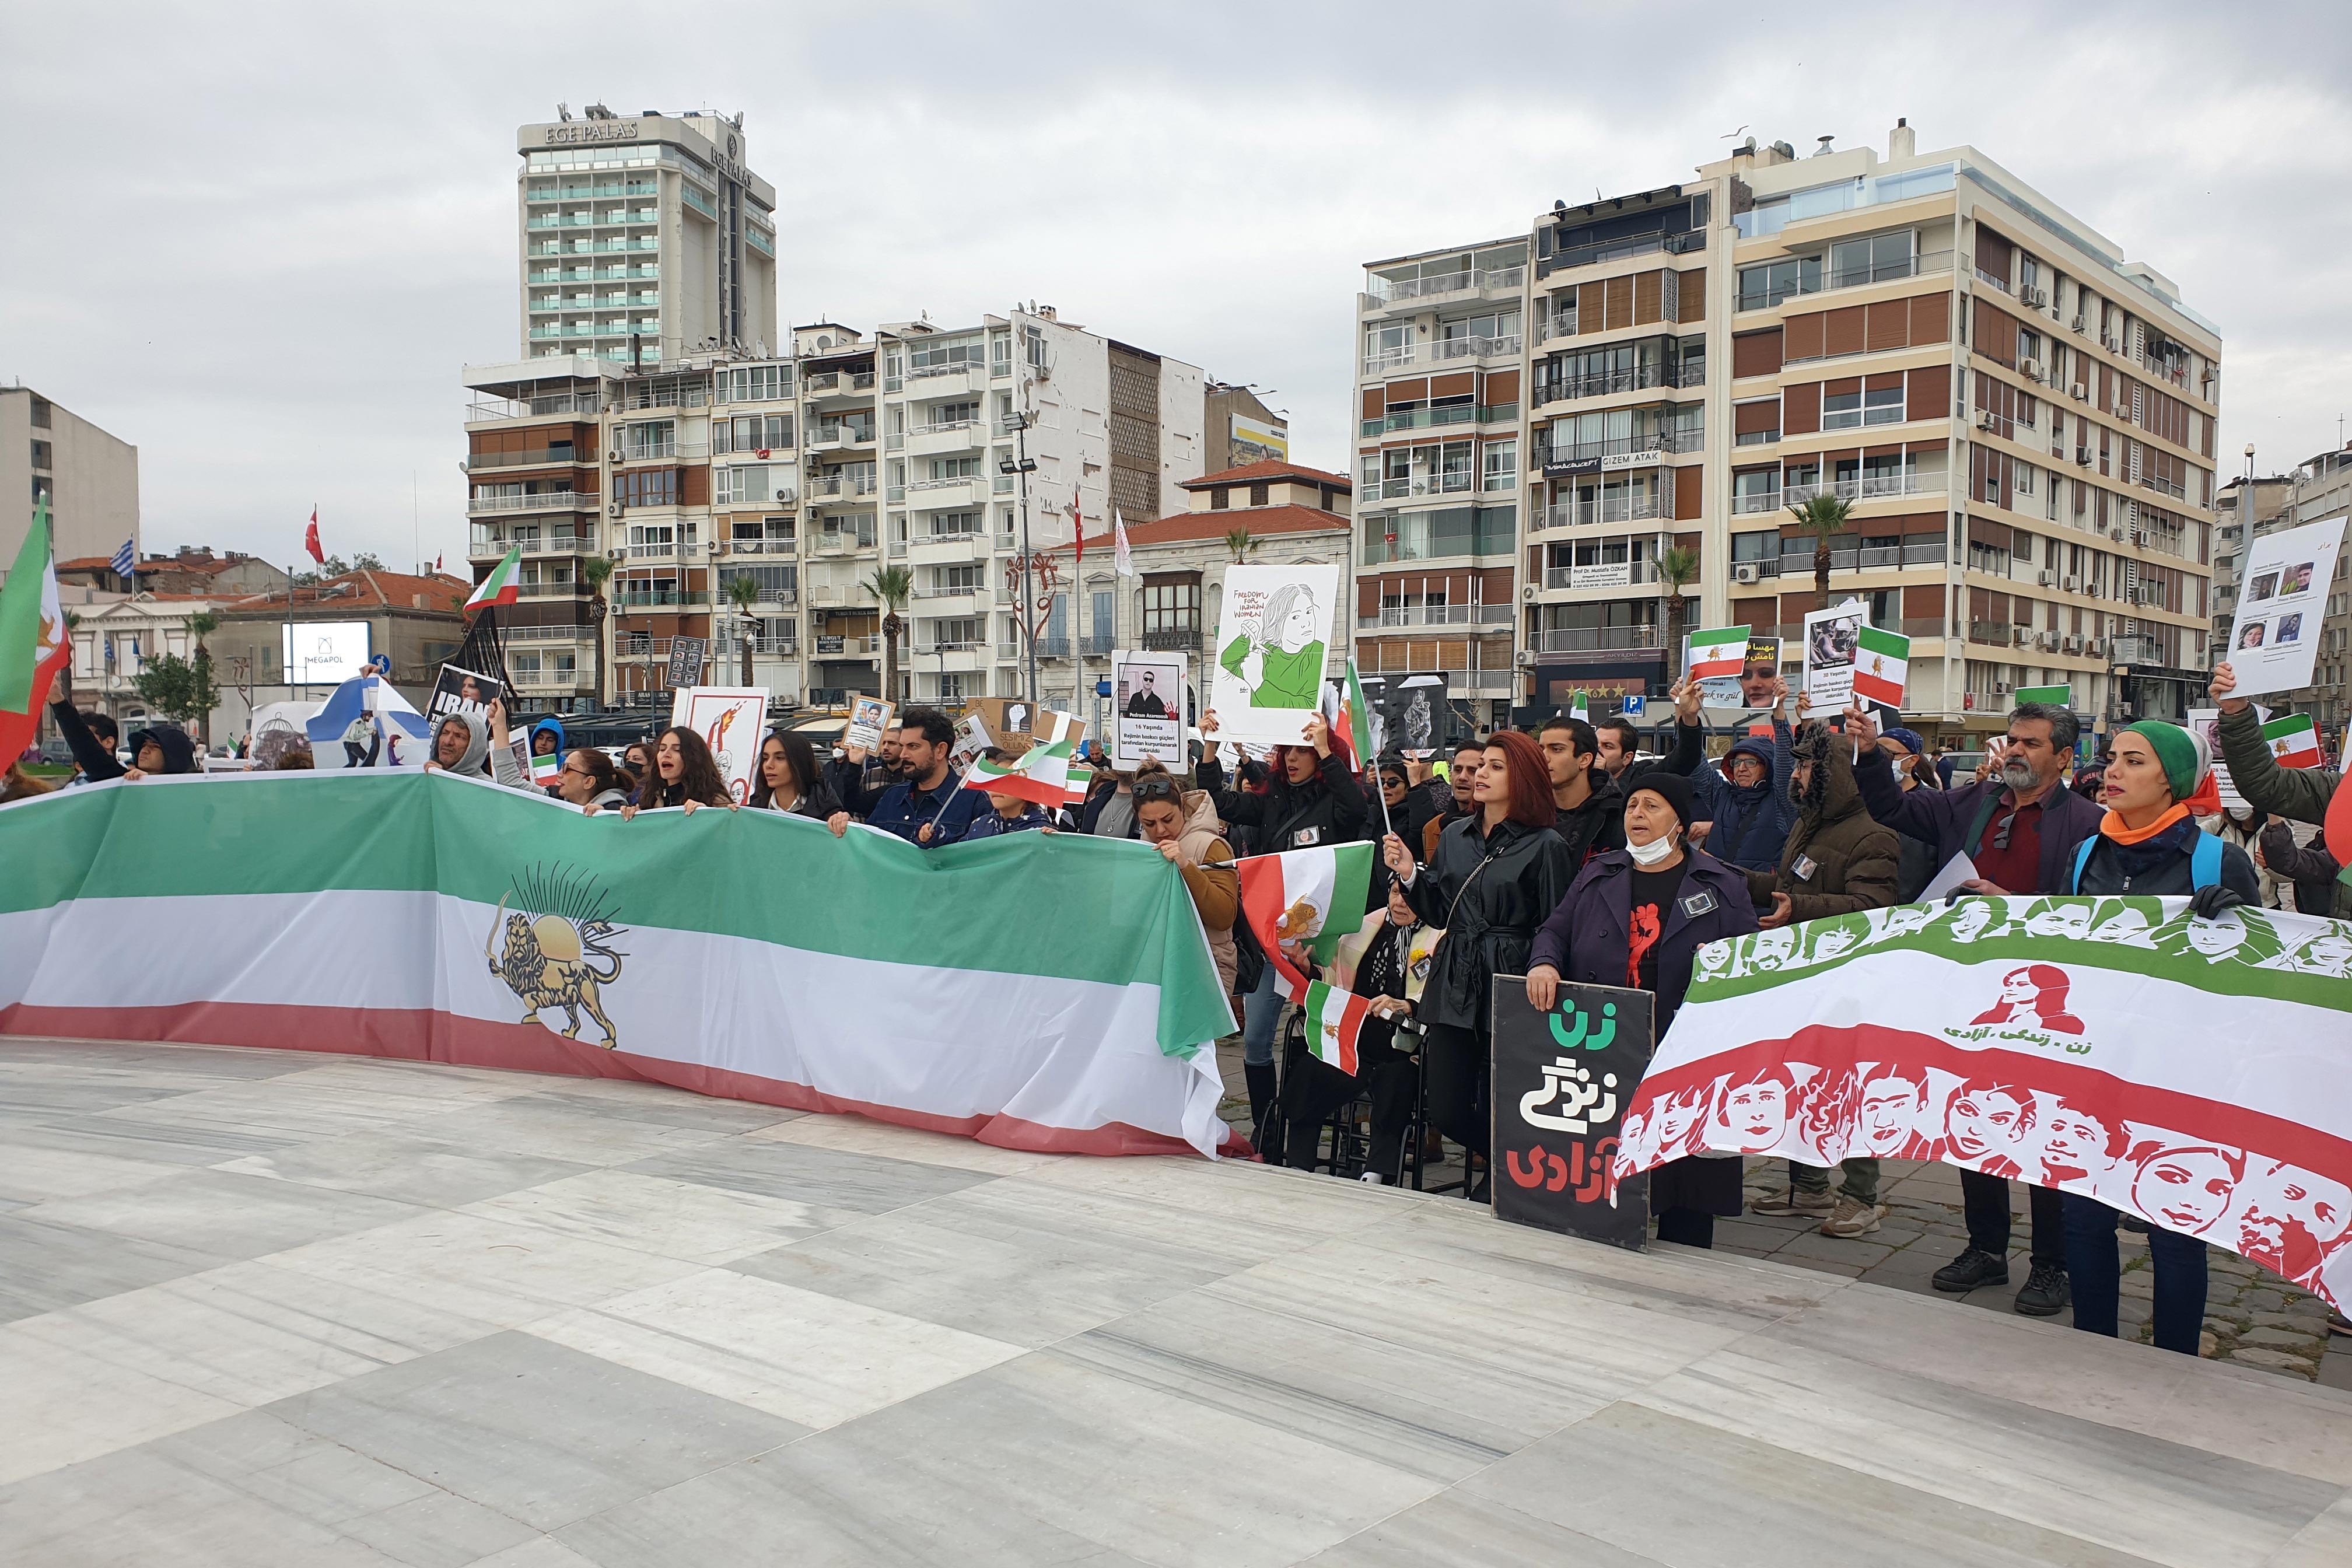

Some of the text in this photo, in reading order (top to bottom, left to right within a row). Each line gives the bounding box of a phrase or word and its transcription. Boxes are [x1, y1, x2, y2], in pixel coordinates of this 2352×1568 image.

[545, 121, 637, 143] EGE PALAS
[711, 146, 752, 188] EGE PALAS
[1634, 452, 1658, 461] ATAK
[1751, 652, 1774, 661] نامش
[1753, 643, 1774, 652] مهسا
[435, 691, 490, 723] IRAN
[1629, 697, 1637, 708] P
[1724, 691, 1741, 701] gül
[1549, 999, 1616, 1051] زن
[1944, 1027, 2092, 1055] زن زندگی آزادی
[1519, 1056, 1618, 1135] زندگی
